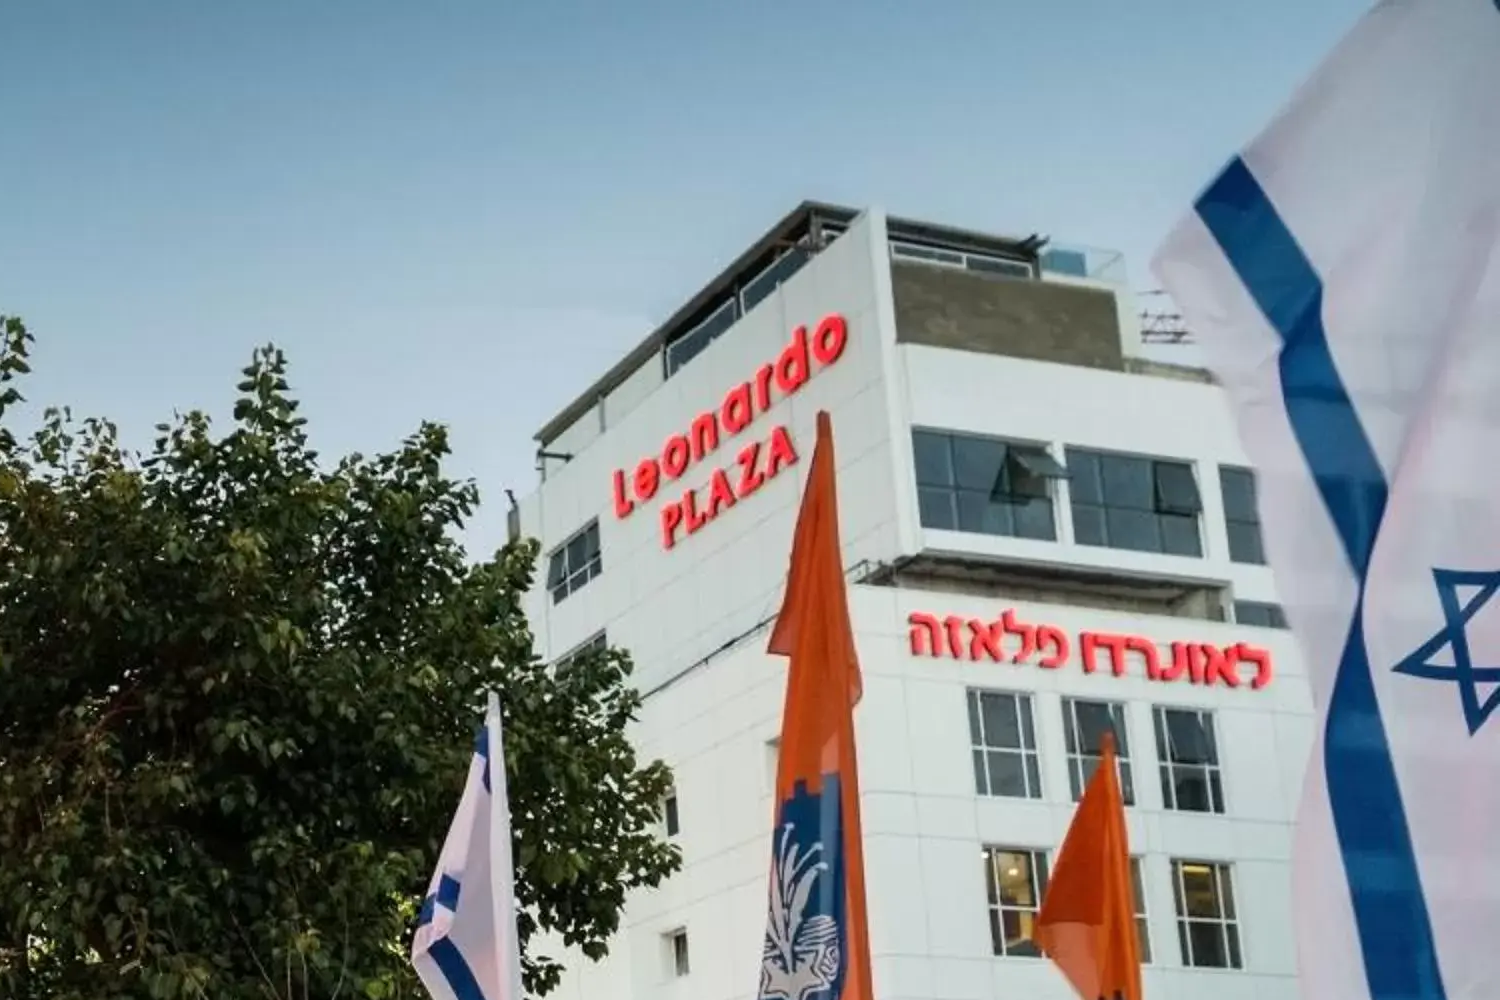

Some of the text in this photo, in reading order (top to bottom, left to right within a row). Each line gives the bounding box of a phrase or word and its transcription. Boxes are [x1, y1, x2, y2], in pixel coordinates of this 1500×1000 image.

[612, 312, 848, 519] Leonardo
[660, 425, 799, 551] PLAZA
[908, 608, 1273, 689] לאונרדו פלאזה
